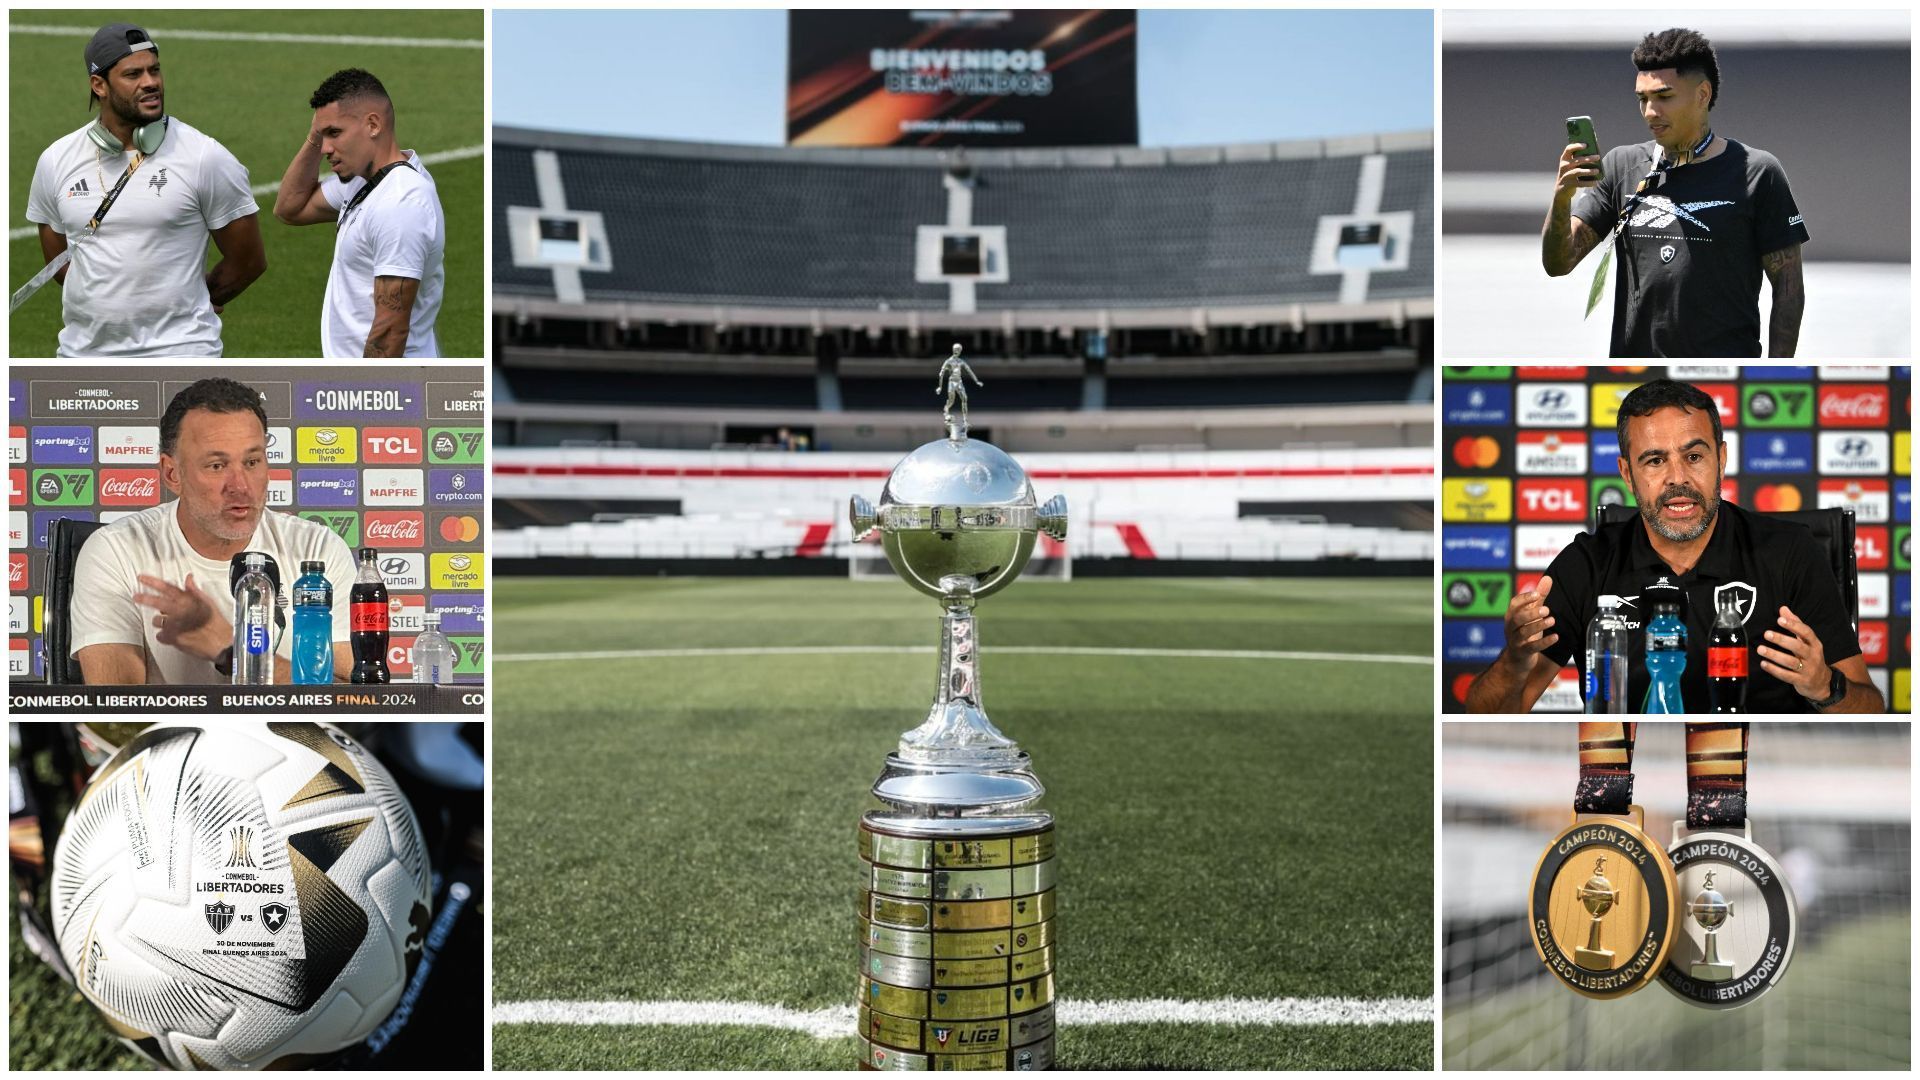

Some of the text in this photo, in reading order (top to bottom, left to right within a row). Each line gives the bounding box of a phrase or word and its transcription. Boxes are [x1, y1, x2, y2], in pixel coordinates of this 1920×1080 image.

[870, 49, 1046, 71] BIENVENIDOS
[885, 71, 1053, 96] BEM-VINDOS
[49, 399, 139, 411] LIBERTADORES
[35, 437, 90, 447] sportingbet
[367, 437, 418, 454] TCL
[78, 446, 89, 454] tv
[105, 446, 154, 455] MAPFRE
[309, 447, 345, 455] mercado
[318, 454, 336, 462] livre
[41, 479, 57, 490] EA
[300, 479, 355, 489] sportingbet
[266, 490, 286, 502] TEL
[343, 488, 353, 496] tv
[369, 488, 418, 497] MAPFRE
[435, 492, 482, 501] crypto.com
[1522, 488, 1581, 511] TCL
[382, 577, 417, 585] YUNDAI
[442, 572, 478, 580] mercado
[452, 580, 469, 588] livre
[251, 605, 262, 648] smart
[388, 616, 419, 628] STEL
[9, 694, 416, 708] CONMEBOL LIBERTADORES BUENOS AIRES FINAL 2024
[1558, 828, 1647, 866] CAMPEÓN 2024
[1671, 843, 1771, 886] CAMPEÓN 2024
[196, 882, 284, 894] LIBERTADORES
[1537, 919, 1578, 983] CONMEBOL
